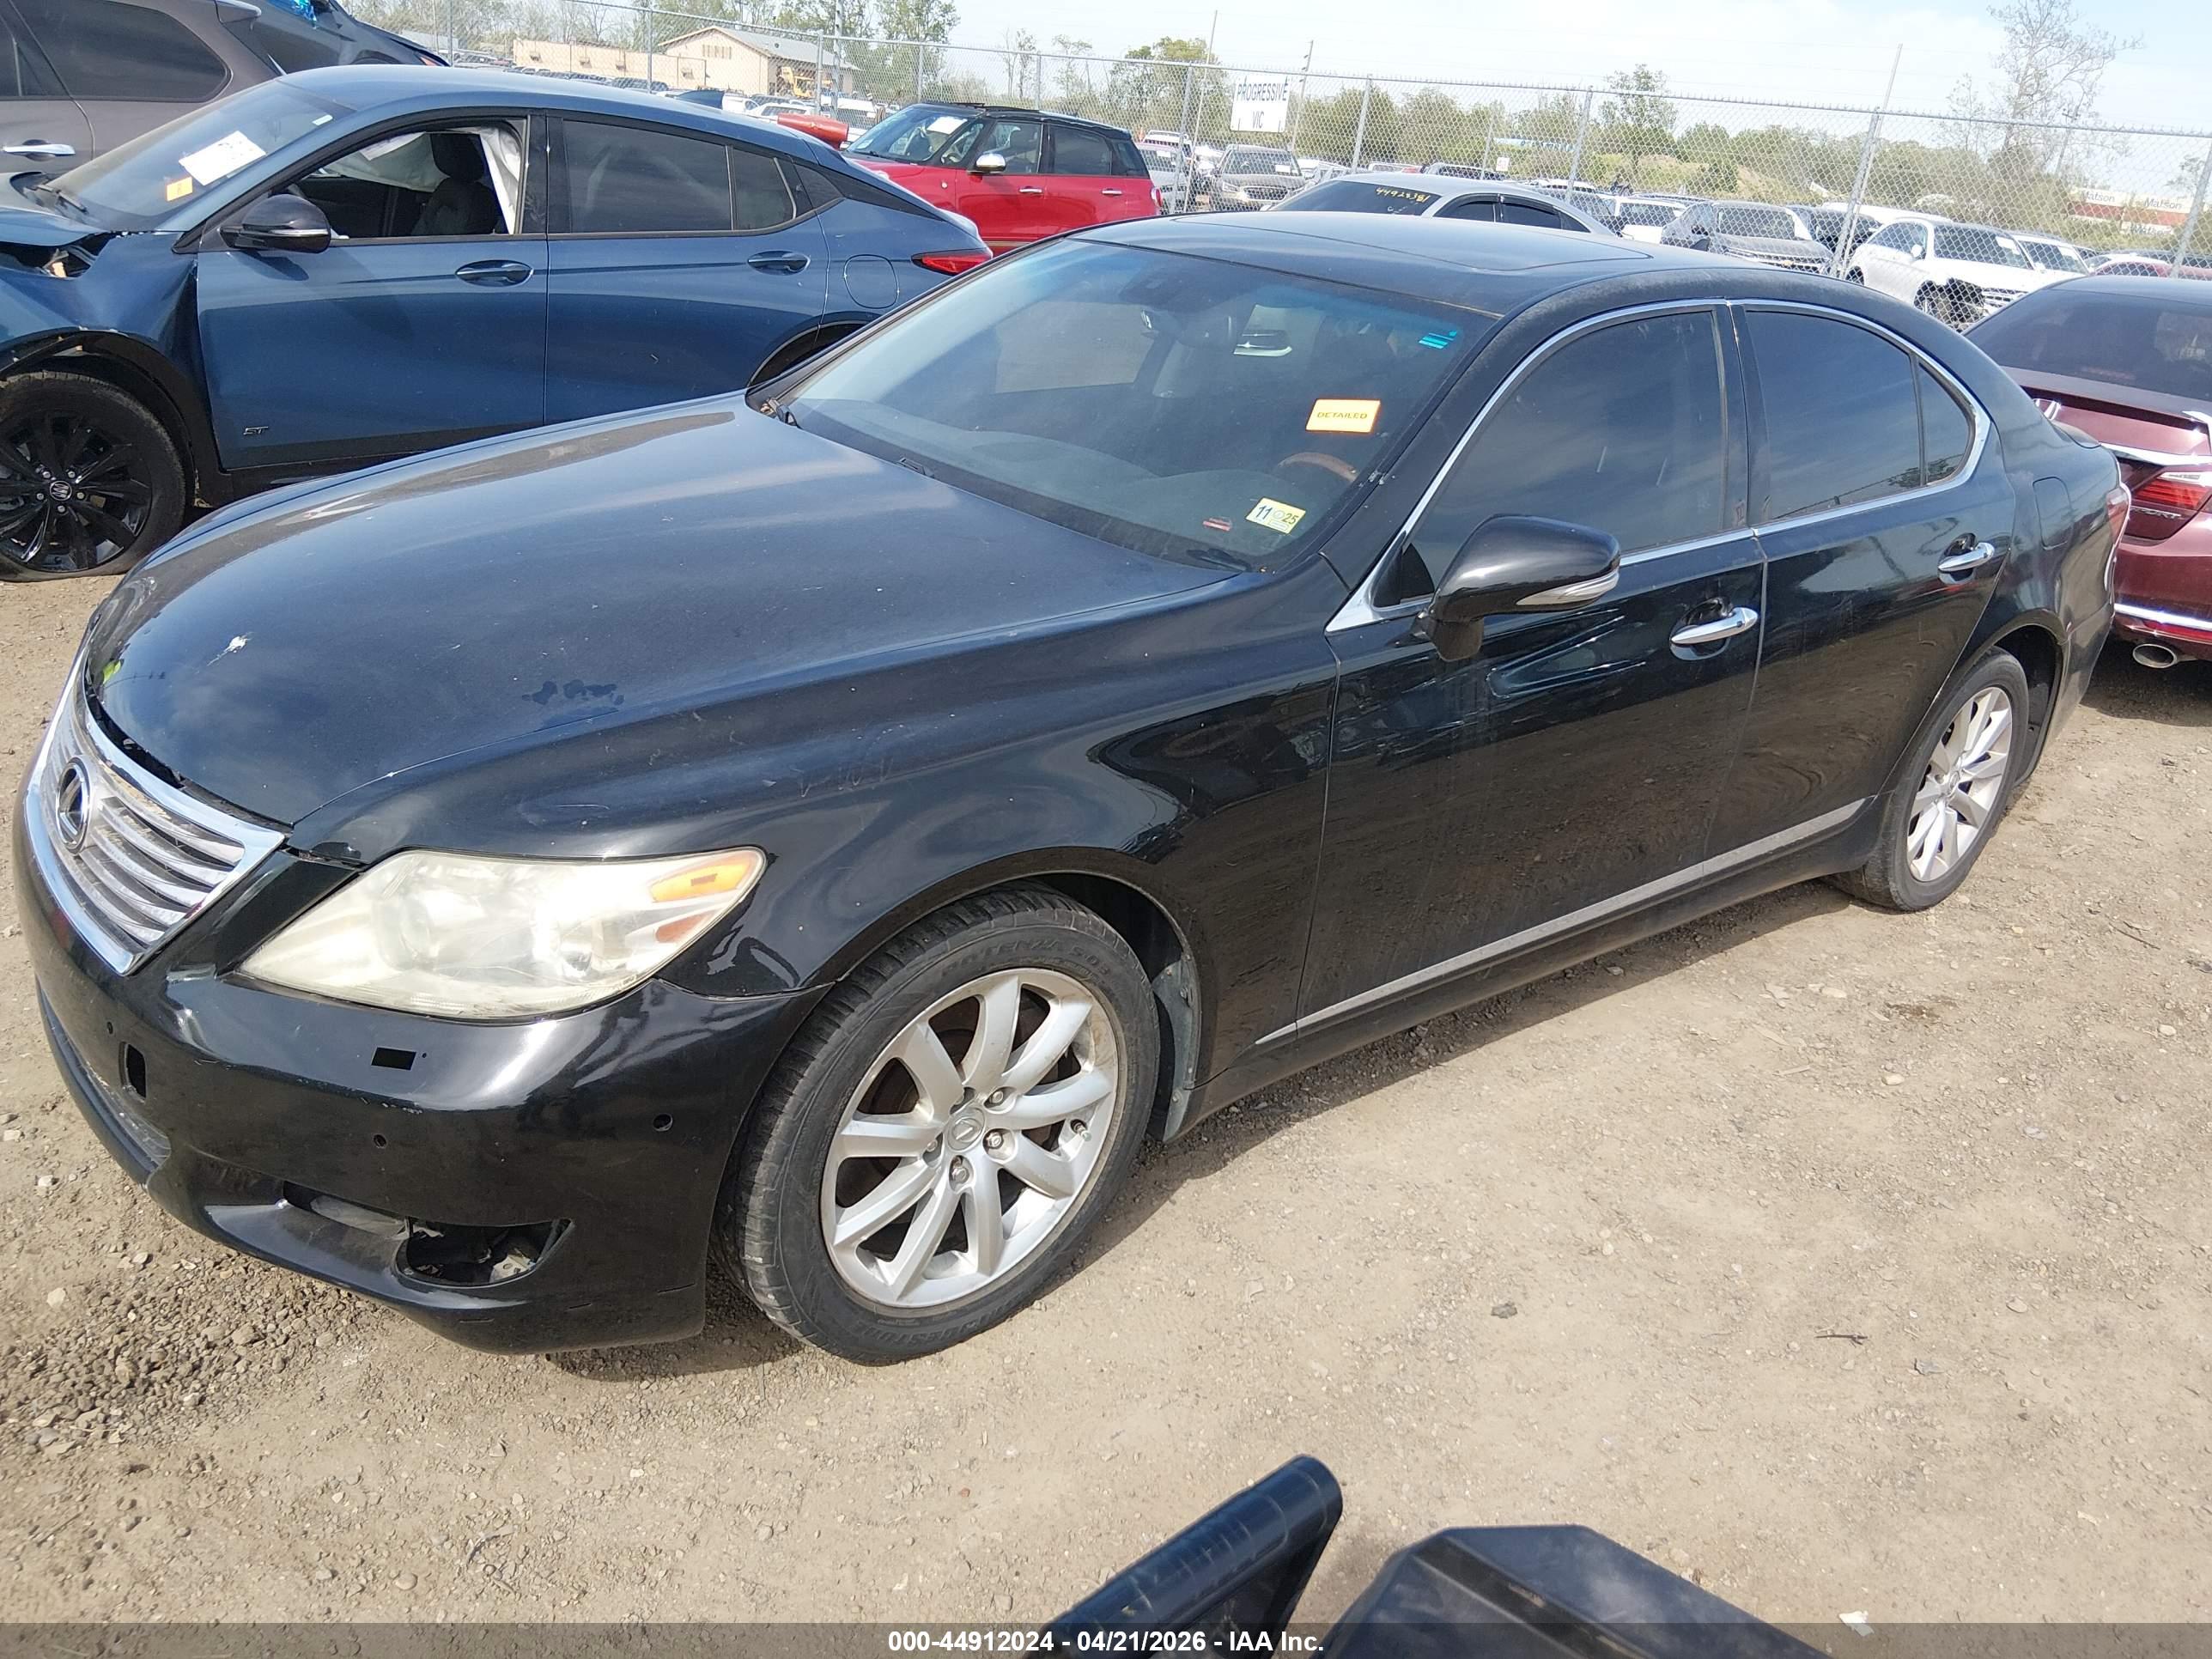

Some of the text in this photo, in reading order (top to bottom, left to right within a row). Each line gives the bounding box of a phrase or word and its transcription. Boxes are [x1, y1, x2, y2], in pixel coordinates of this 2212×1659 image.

[1237, 82, 1289, 101] PROGRESSIVE
[1252, 111, 1265, 129] VIC
[2081, 191, 2116, 203] Matson
[2143, 198, 2183, 210] Matson
[1316, 411, 1368, 420] DETAILED
[243, 426, 269, 435] ST
[1255, 505, 1299, 526] 11 25
[2130, 505, 2183, 520] PORT
